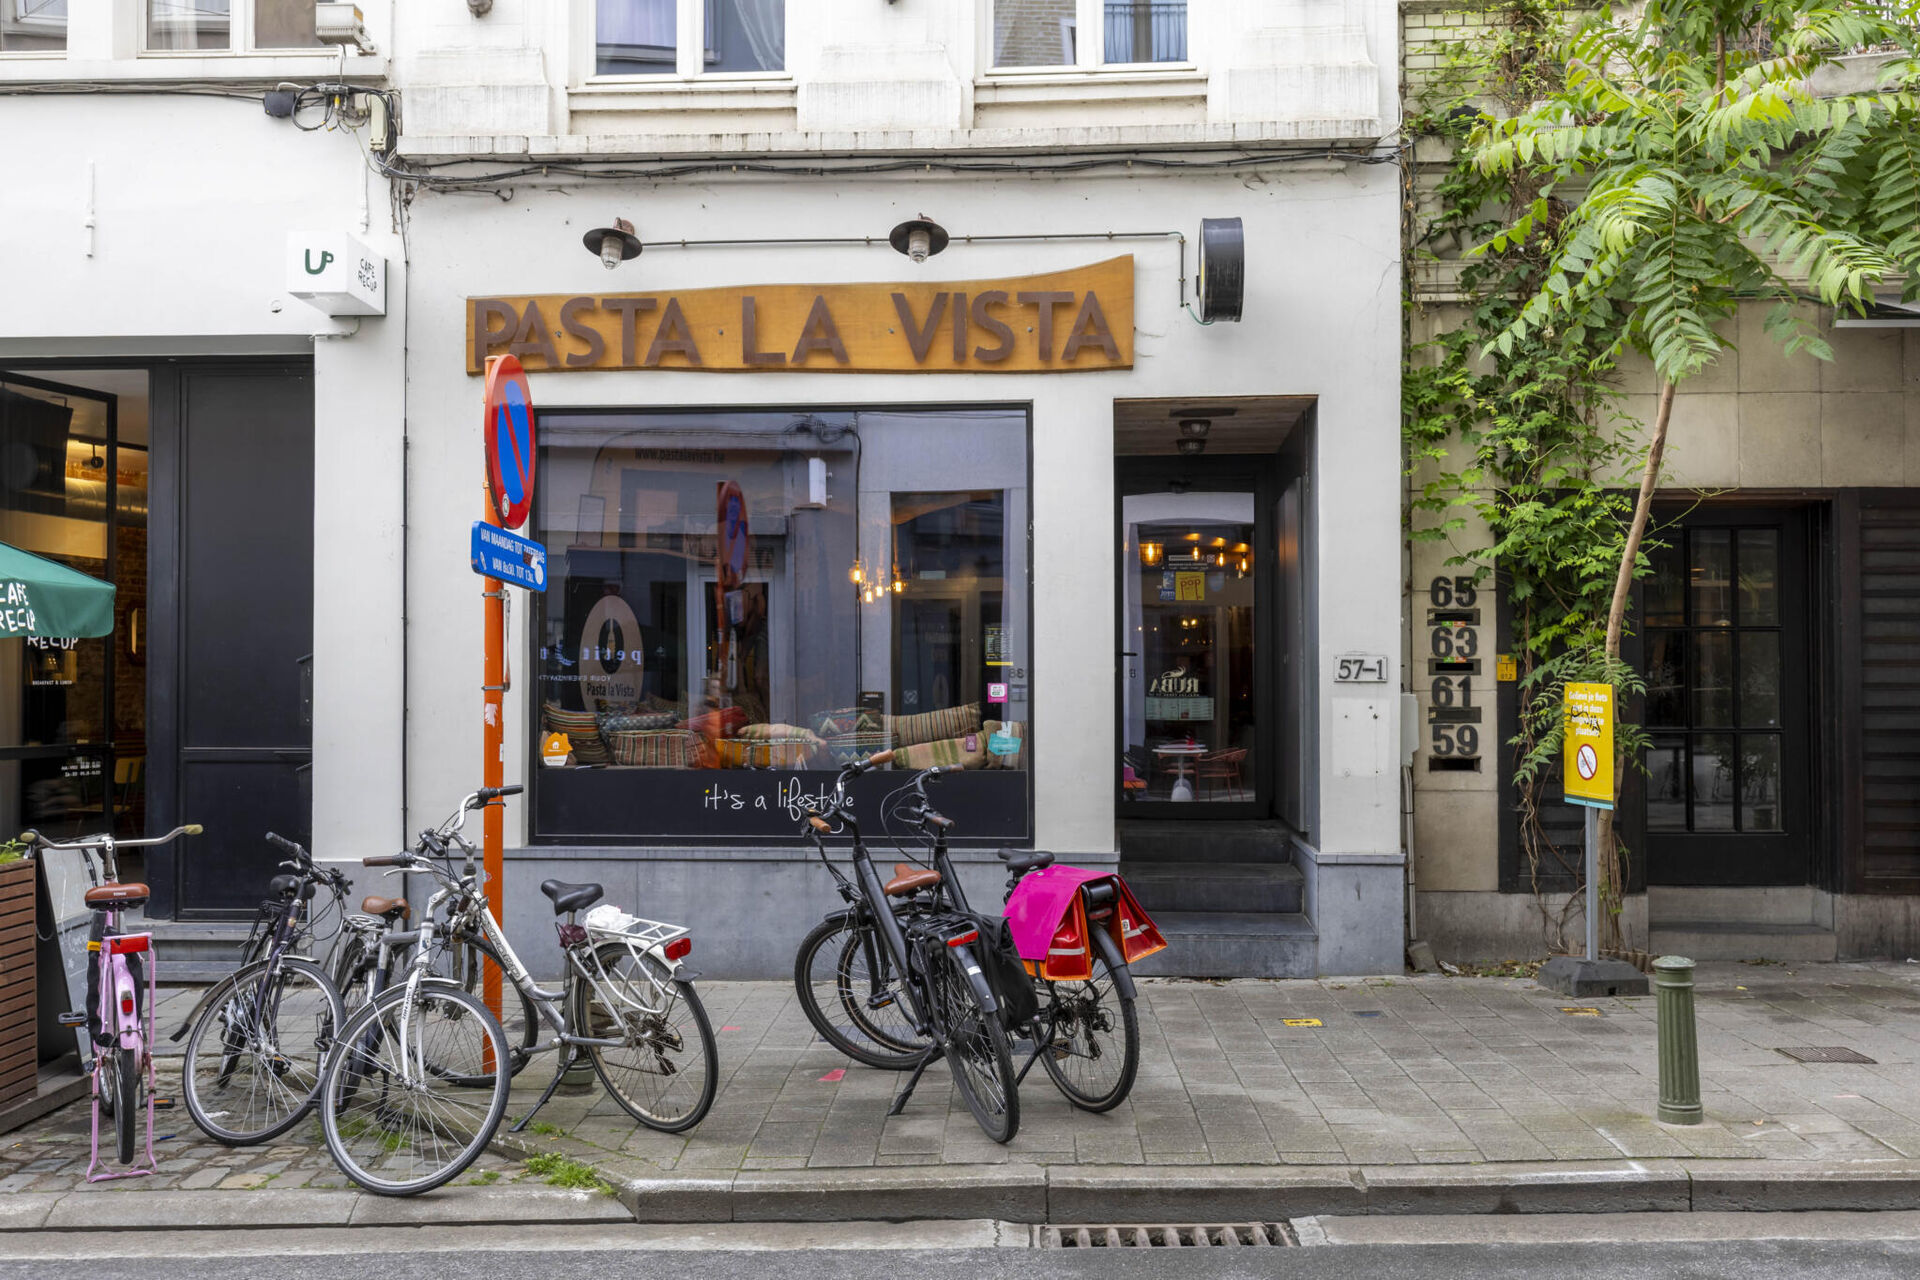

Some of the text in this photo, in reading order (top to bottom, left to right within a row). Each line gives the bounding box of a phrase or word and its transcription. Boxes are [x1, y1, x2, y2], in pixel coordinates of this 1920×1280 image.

[358, 270, 377, 292] RECUP
[474, 290, 1121, 369] PASTA LA VISTA
[481, 528, 490, 543] VAN
[491, 532, 514, 552] MAANDAG
[514, 541, 522, 555] TOT
[492, 557, 502, 572] VAN
[516, 565, 524, 579] TOT
[1430, 576, 1477, 607] 65
[1431, 626, 1478, 658] 63
[1338, 659, 1384, 680] 57-1
[587, 683, 634, 697] Pasta la Vista
[1431, 676, 1471, 707] 61
[1432, 724, 1478, 756] 59
[705, 783, 745, 810] it's
[755, 795, 767, 810] a
